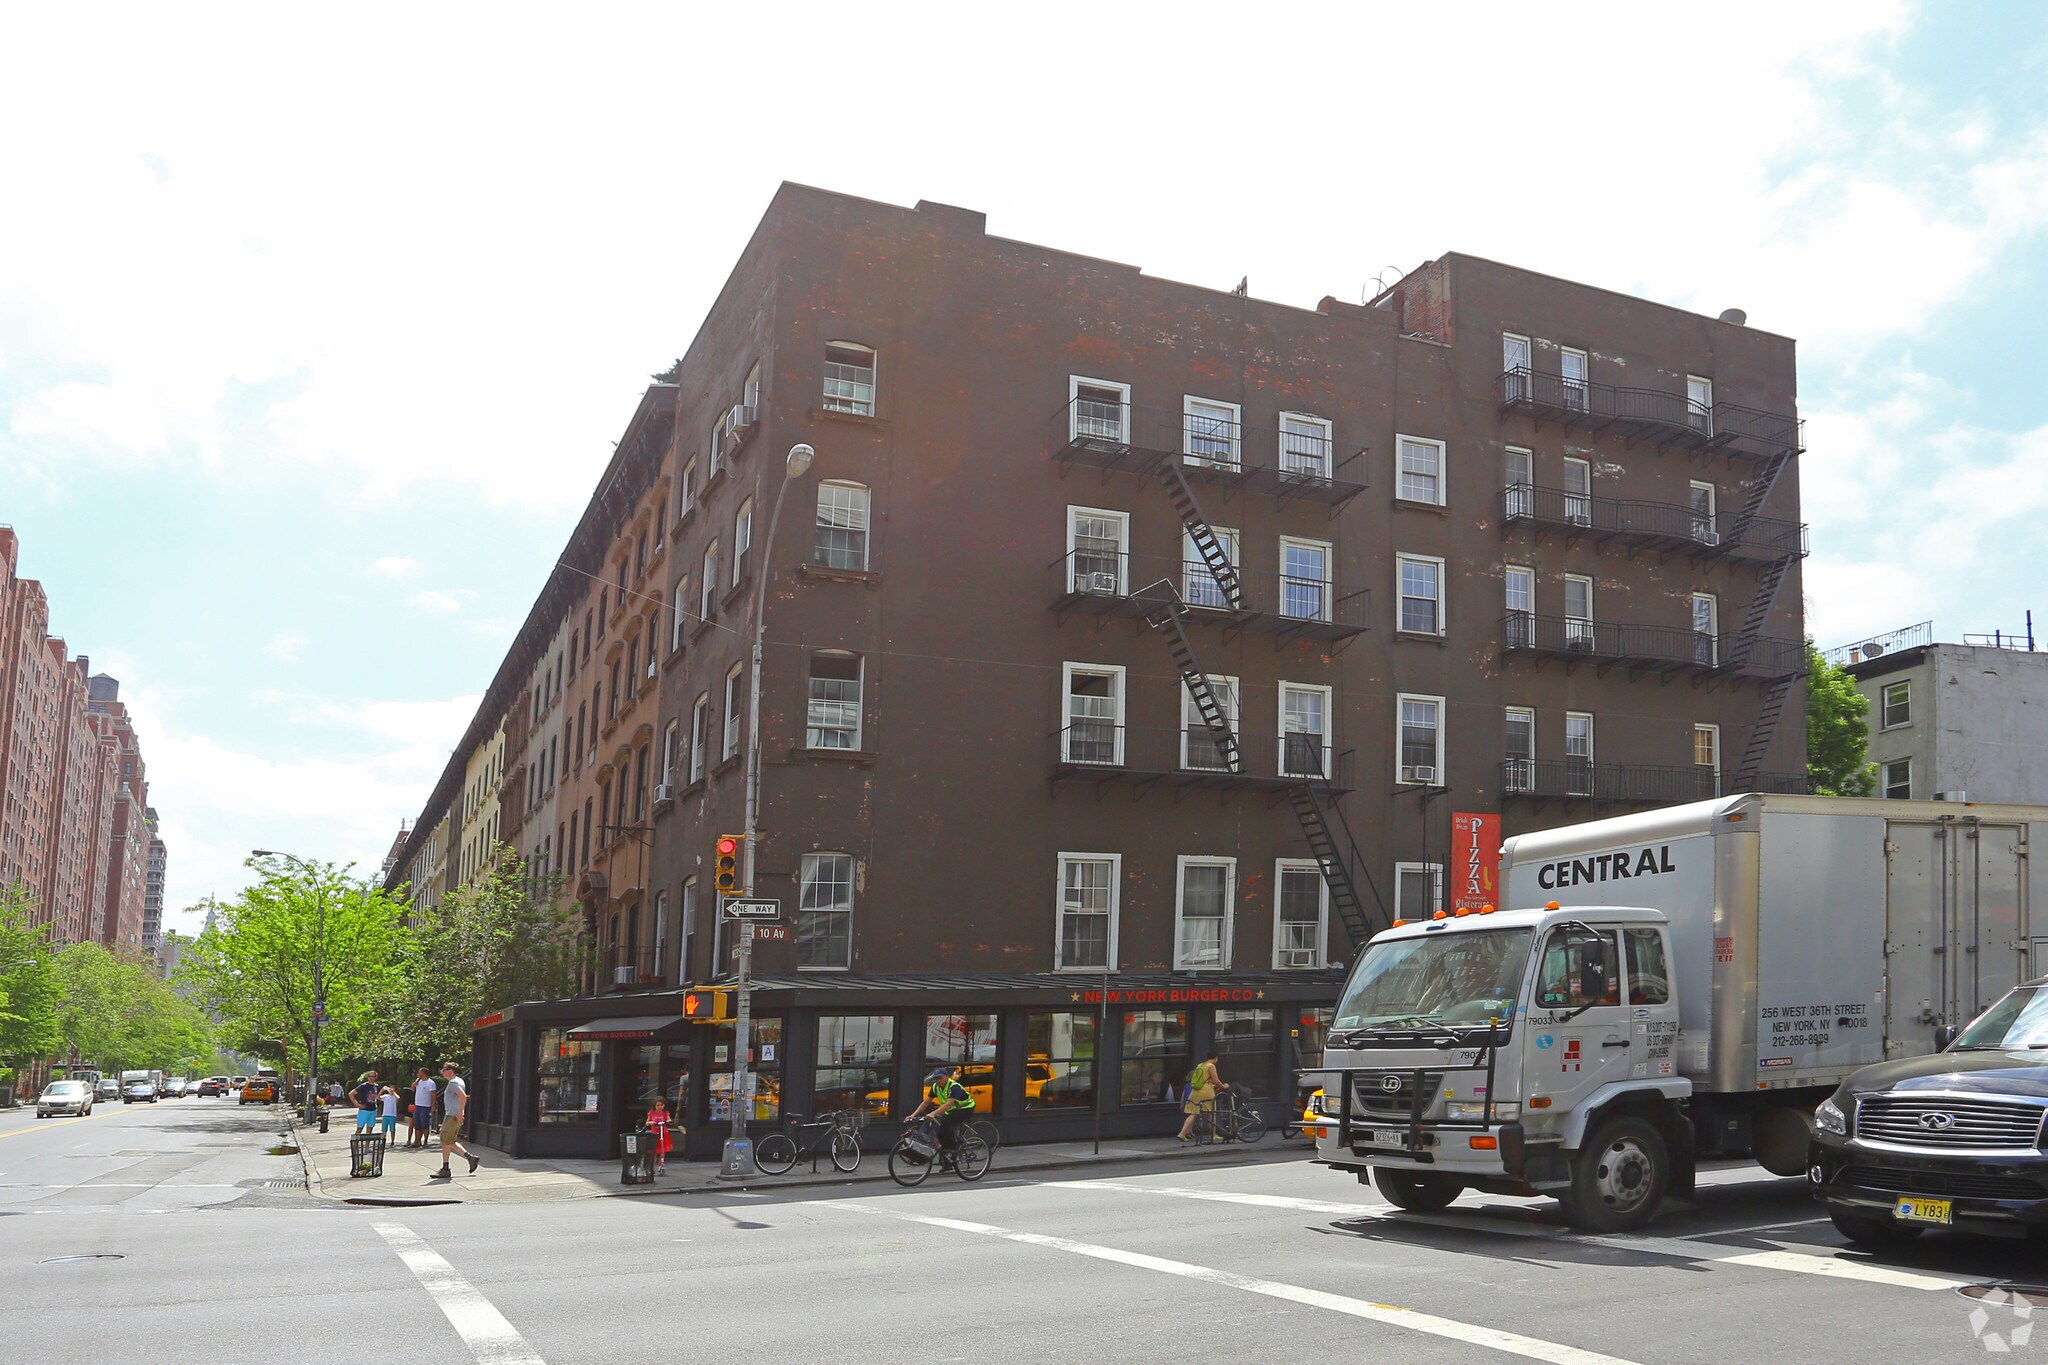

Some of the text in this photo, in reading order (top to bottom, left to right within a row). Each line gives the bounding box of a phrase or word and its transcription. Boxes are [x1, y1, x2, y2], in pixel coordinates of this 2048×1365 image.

[1466, 817, 1483, 894] PIZZA
[1538, 845, 1676, 890] CENTRAL
[731, 904, 773, 913] ONE WAY
[1455, 899, 1494, 909] Ristoran
[760, 928, 785, 939] 10 Av
[1084, 987, 1253, 1003] NEW YORK BURGER CO
[1762, 1004, 1867, 1018] 256 WEST 36TH STREET
[1528, 1016, 1553, 1025] 79033
[1772, 1021, 1791, 1032] NEW
[1820, 1018, 1831, 1030] NY
[609, 1031, 637, 1039] BURGER
[764, 1046, 772, 1057] A
[1914, 1203, 1943, 1218] LY83
